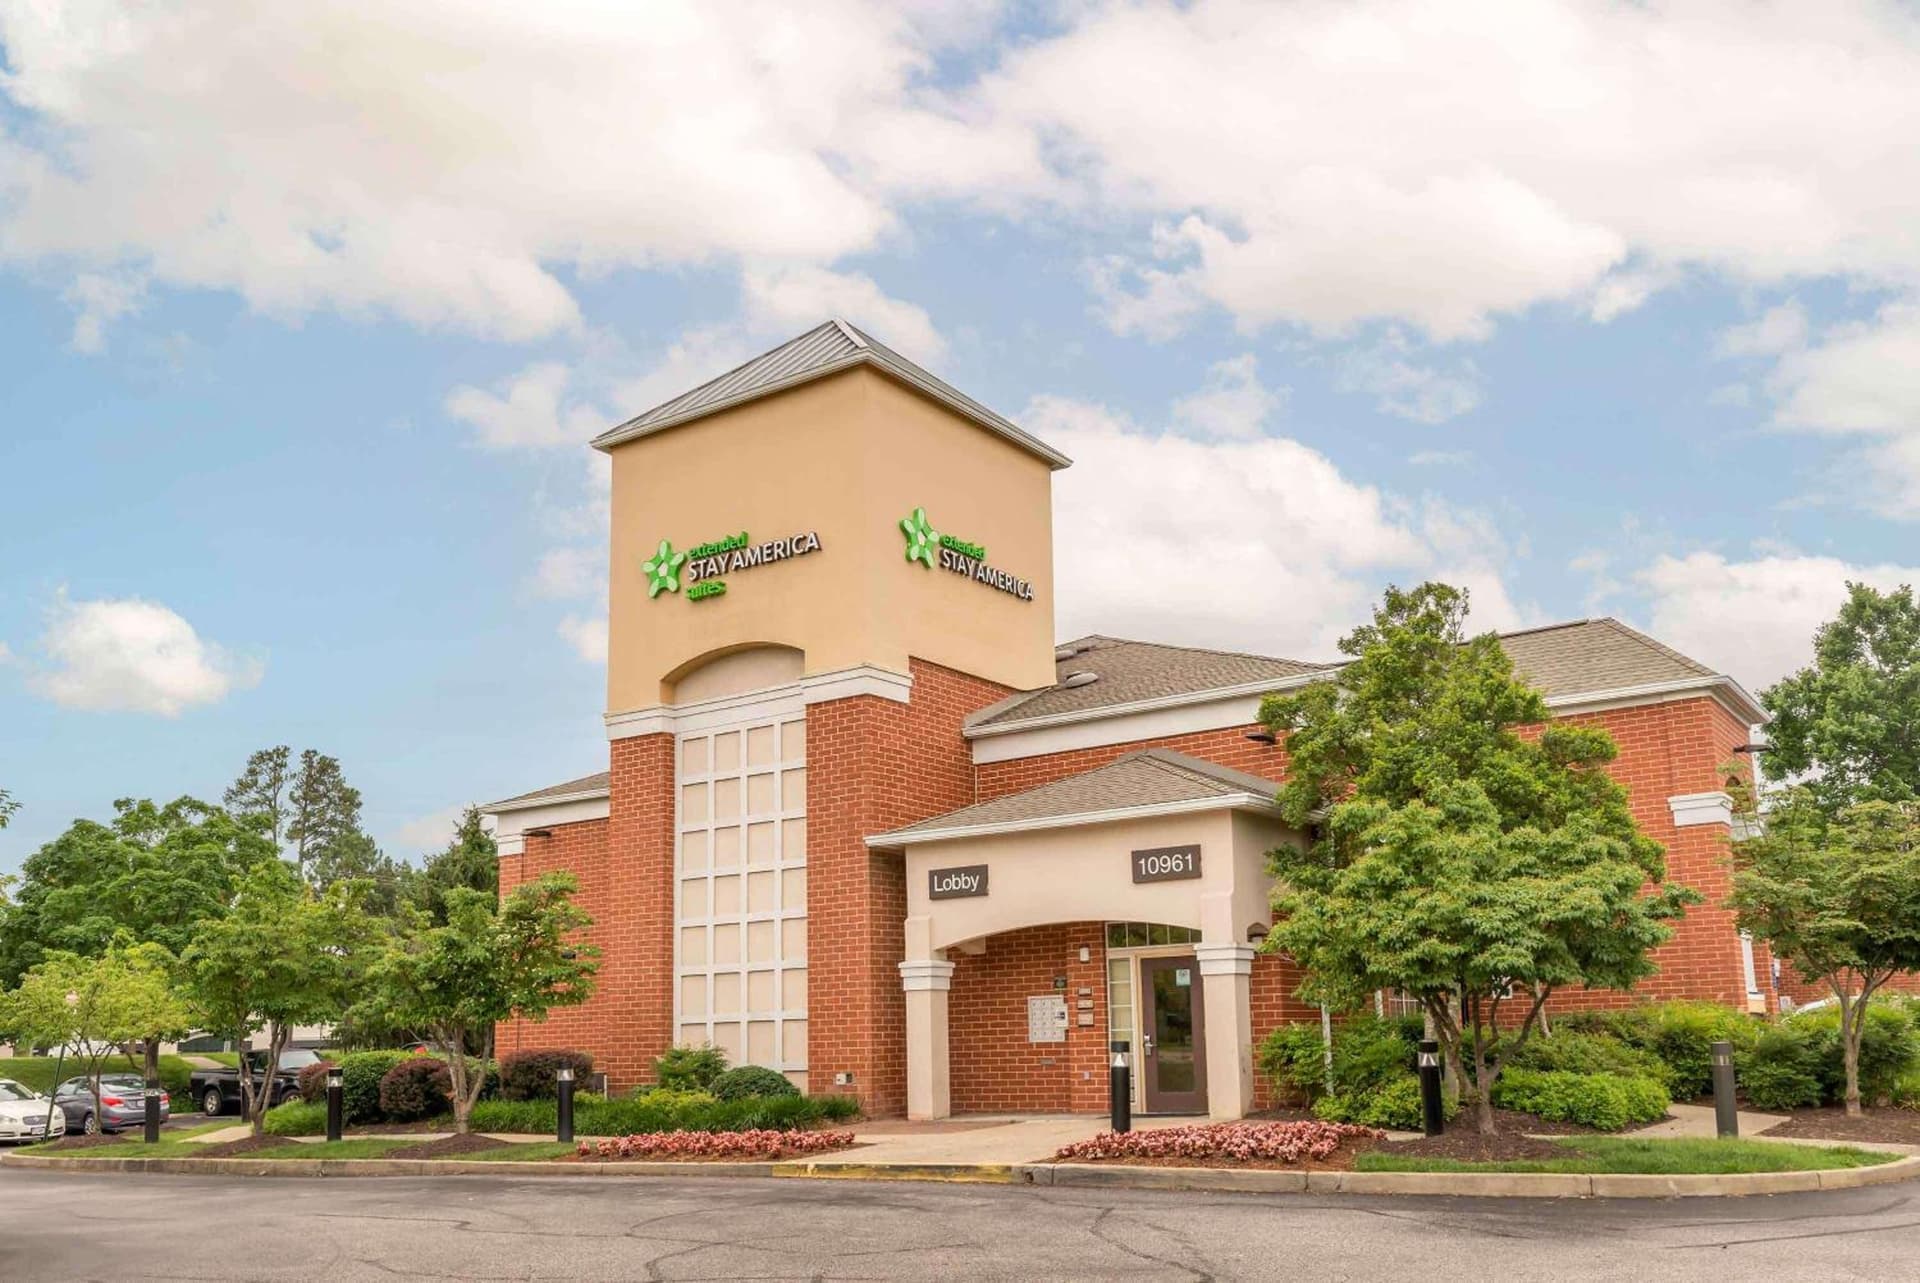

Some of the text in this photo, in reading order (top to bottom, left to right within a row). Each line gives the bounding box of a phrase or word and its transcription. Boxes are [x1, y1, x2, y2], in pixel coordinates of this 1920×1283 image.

[689, 531, 748, 560] extended
[941, 548, 1034, 601] STAY AMERICA
[1138, 853, 1194, 876] 10961
[933, 873, 980, 893] Lobby
